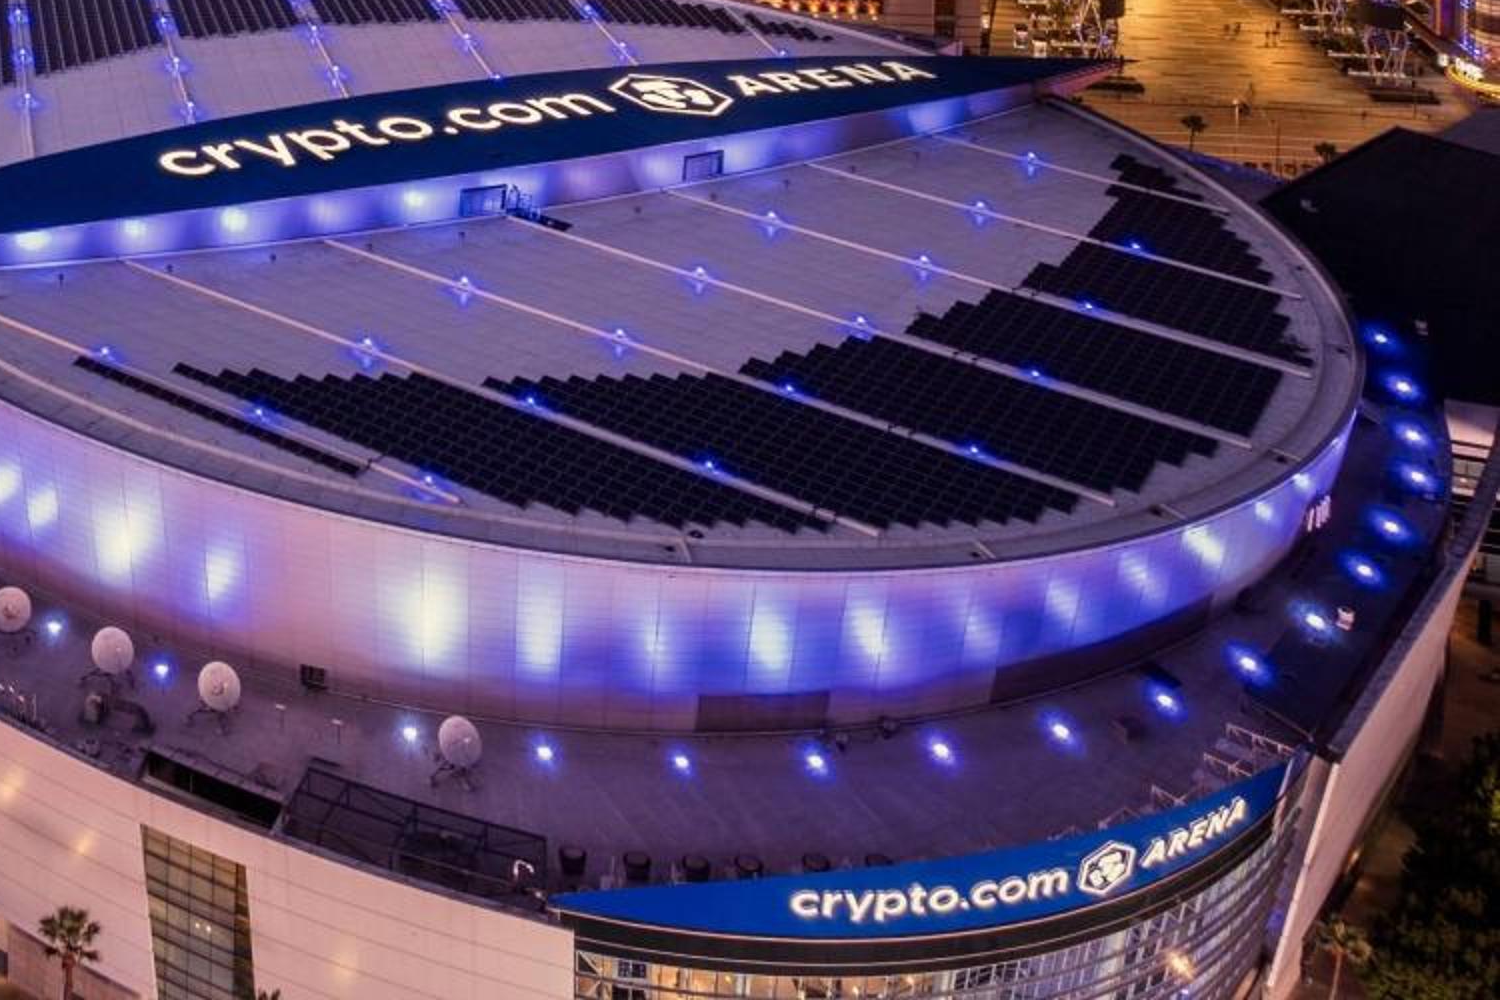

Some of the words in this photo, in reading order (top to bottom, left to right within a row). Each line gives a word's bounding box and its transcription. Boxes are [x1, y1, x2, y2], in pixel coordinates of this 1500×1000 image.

[158, 90, 616, 177] crypto.com
[726, 60, 937, 97] ARENA
[788, 866, 1070, 923] crypto.com
[1138, 796, 1248, 869] ARENA
